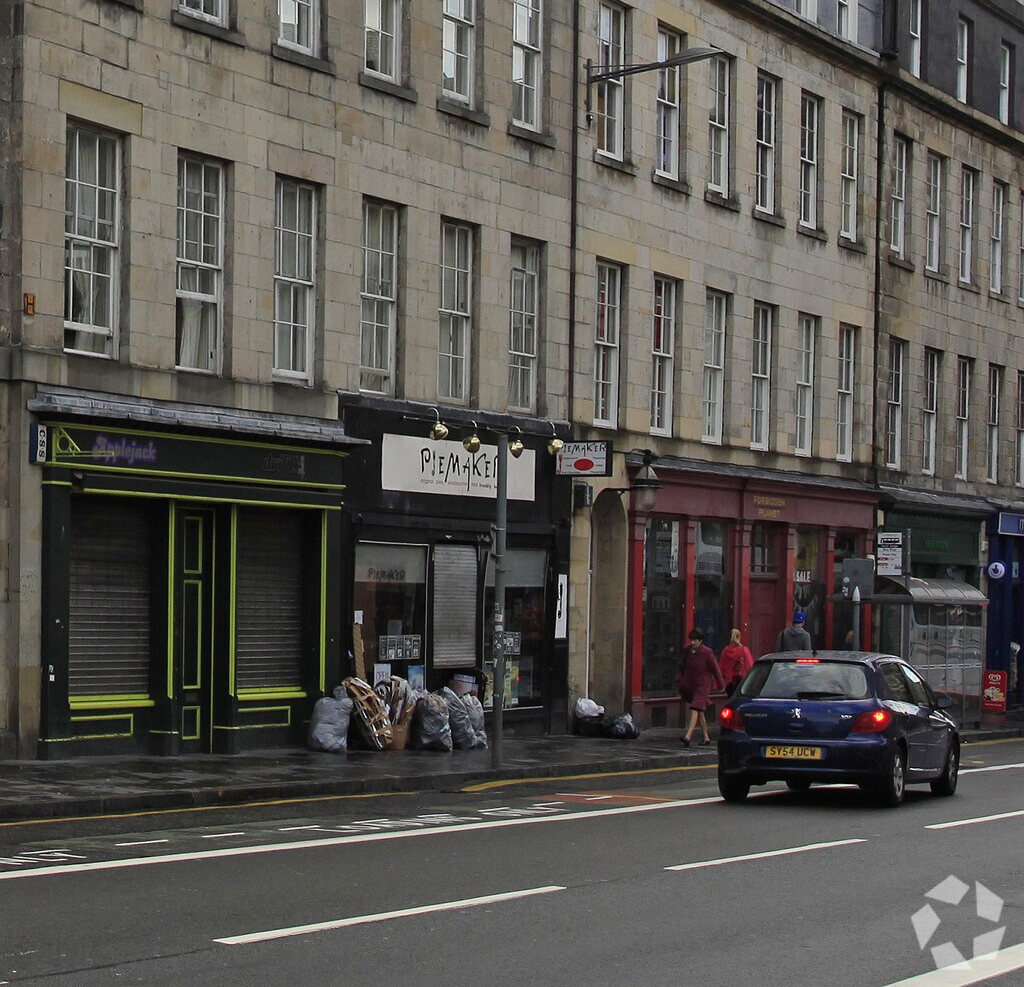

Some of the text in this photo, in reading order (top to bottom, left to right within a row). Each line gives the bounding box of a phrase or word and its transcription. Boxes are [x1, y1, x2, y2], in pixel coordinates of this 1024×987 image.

[561, 442, 607, 457] IEMAKER
[753, 495, 786, 507] FORBIDDEN
[758, 508, 780, 518] PLANET
[796, 570, 811, 583] SALE
[770, 746, 816, 757] SY54 UCW
